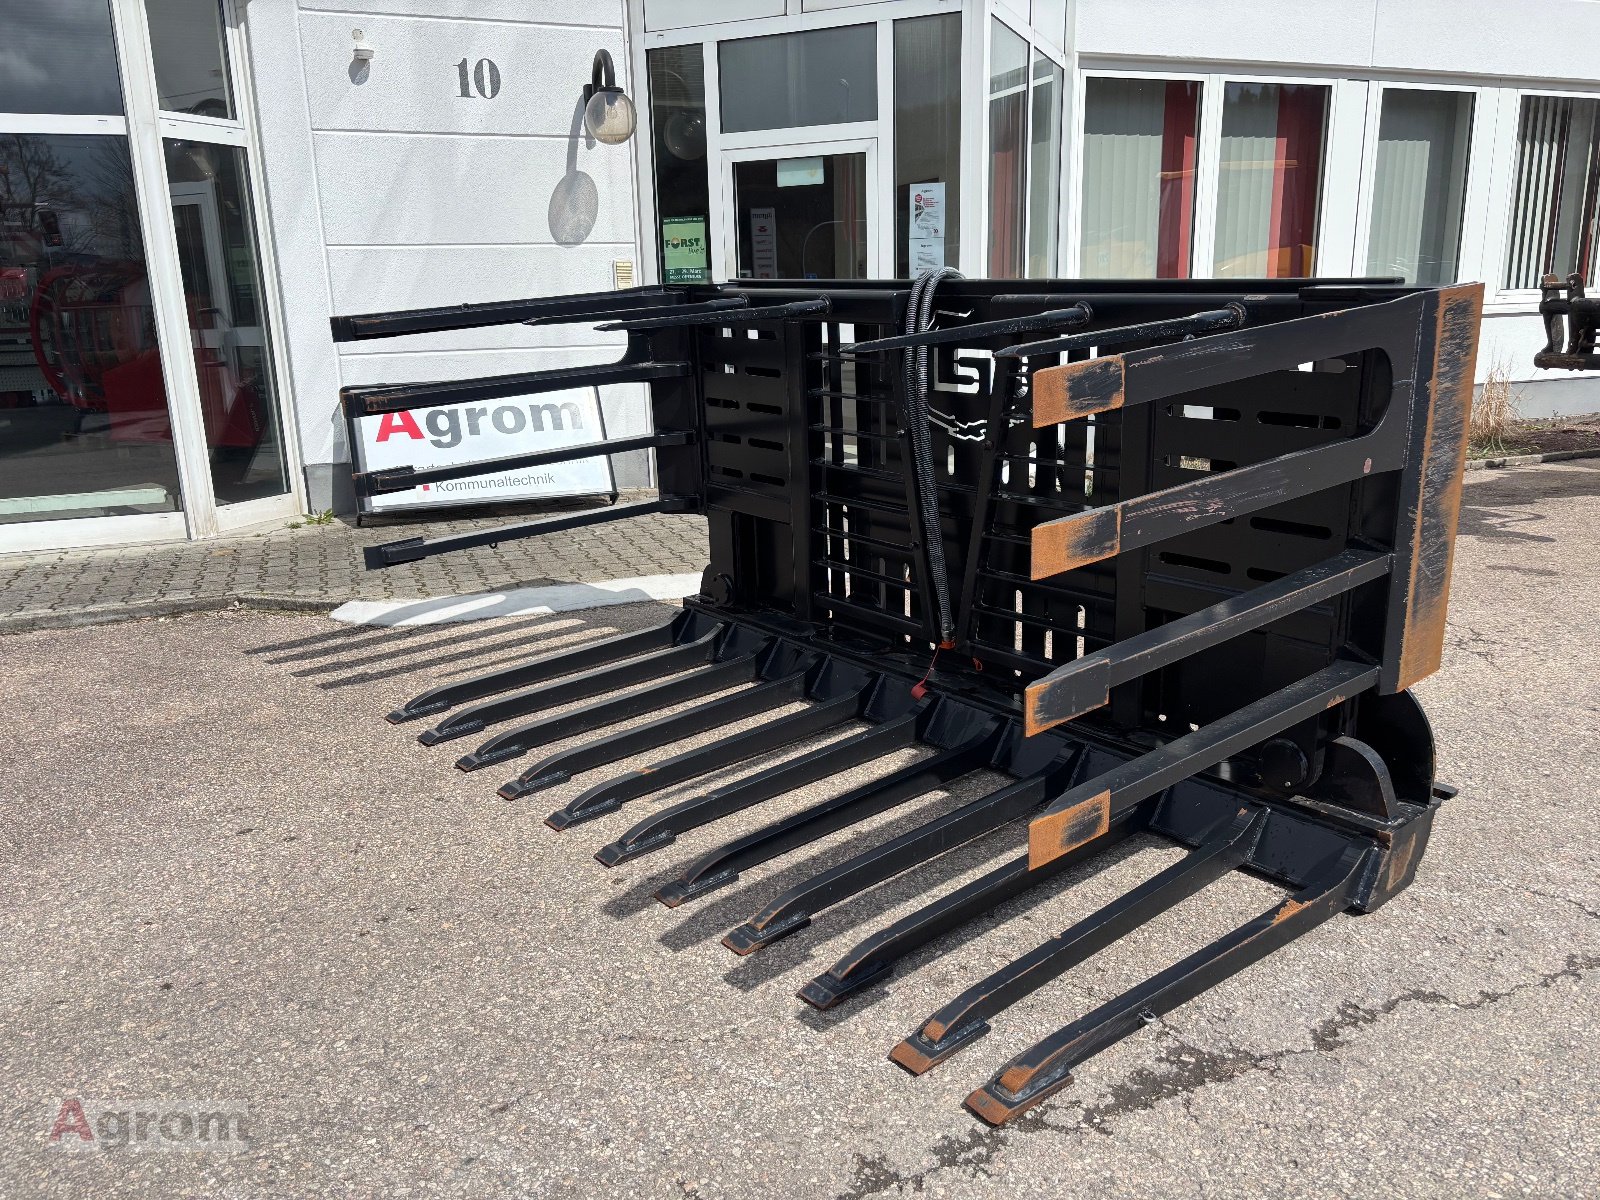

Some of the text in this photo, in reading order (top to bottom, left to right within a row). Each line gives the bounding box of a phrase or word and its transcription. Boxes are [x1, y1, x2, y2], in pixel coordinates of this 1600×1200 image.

[453, 57, 501, 99] 10
[665, 237, 700, 249] FORST
[376, 401, 584, 449] Agrom
[435, 472, 556, 493] Kommunaltechnik
